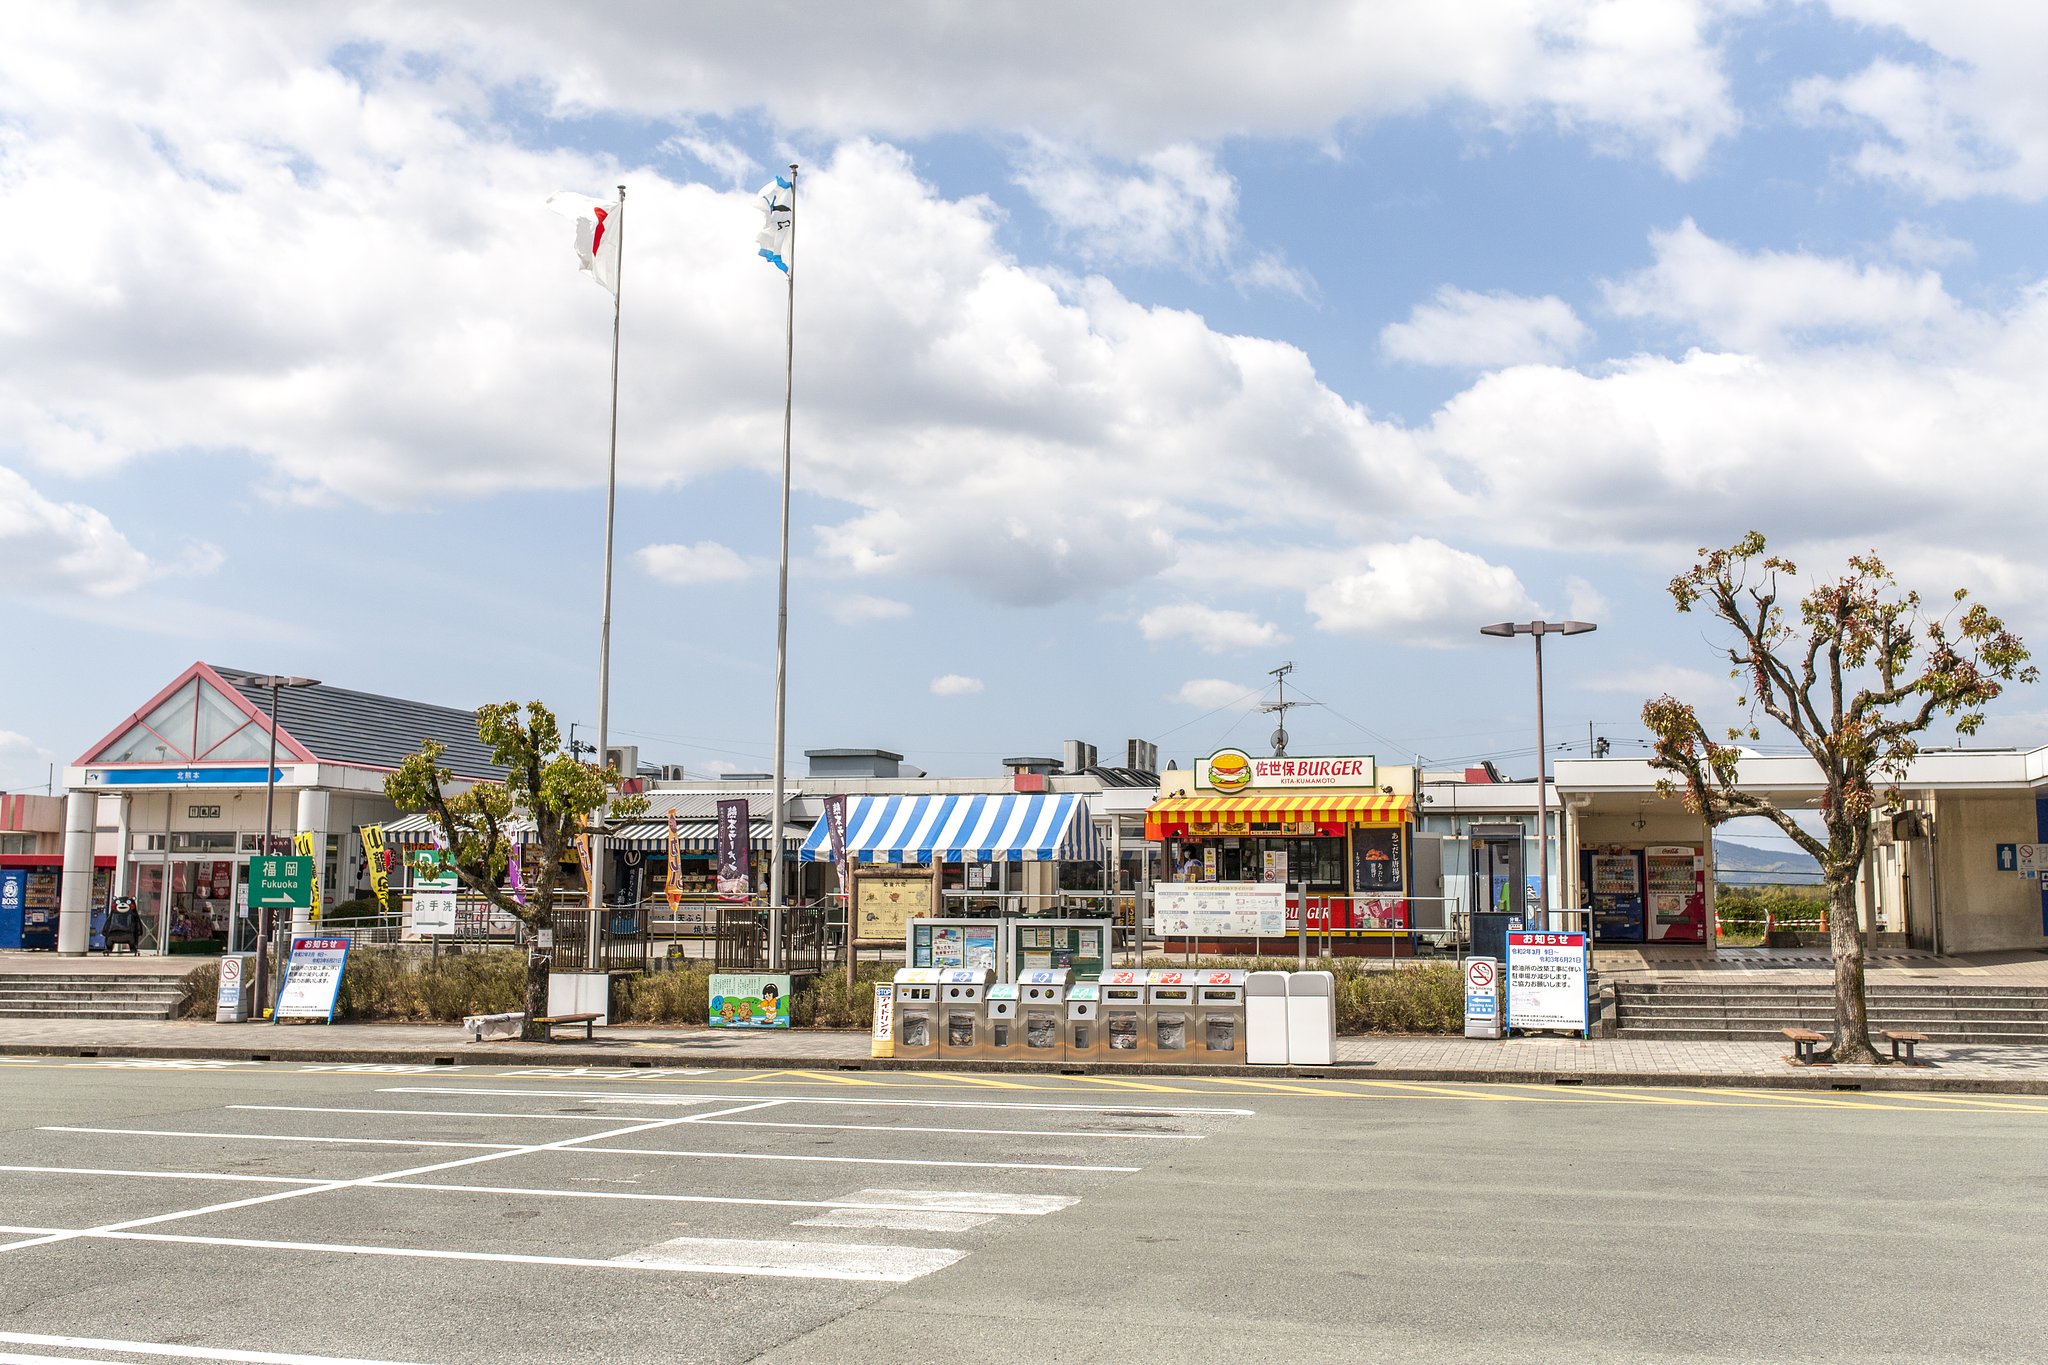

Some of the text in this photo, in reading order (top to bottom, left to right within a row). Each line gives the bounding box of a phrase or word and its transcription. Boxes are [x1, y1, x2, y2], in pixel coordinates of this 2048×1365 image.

[1255, 760, 1363, 777] 佐世保 BURGER
[176, 771, 200, 780] 北熊本
[726, 805, 738, 872] 熊本ラーメン
[1391, 832, 1400, 883] あごだし唐揚げ
[263, 861, 298, 877] 福岡
[261, 879, 298, 889] Fukuoka
[1, 897, 19, 905] BOSS
[1285, 907, 1329, 919] BUGER
[304, 940, 338, 949] お知らせ
[1522, 934, 1569, 945] お知らせ
[1511, 980, 1571, 988] ご協力お願いします。
[880, 996, 891, 1035] アイドリング
